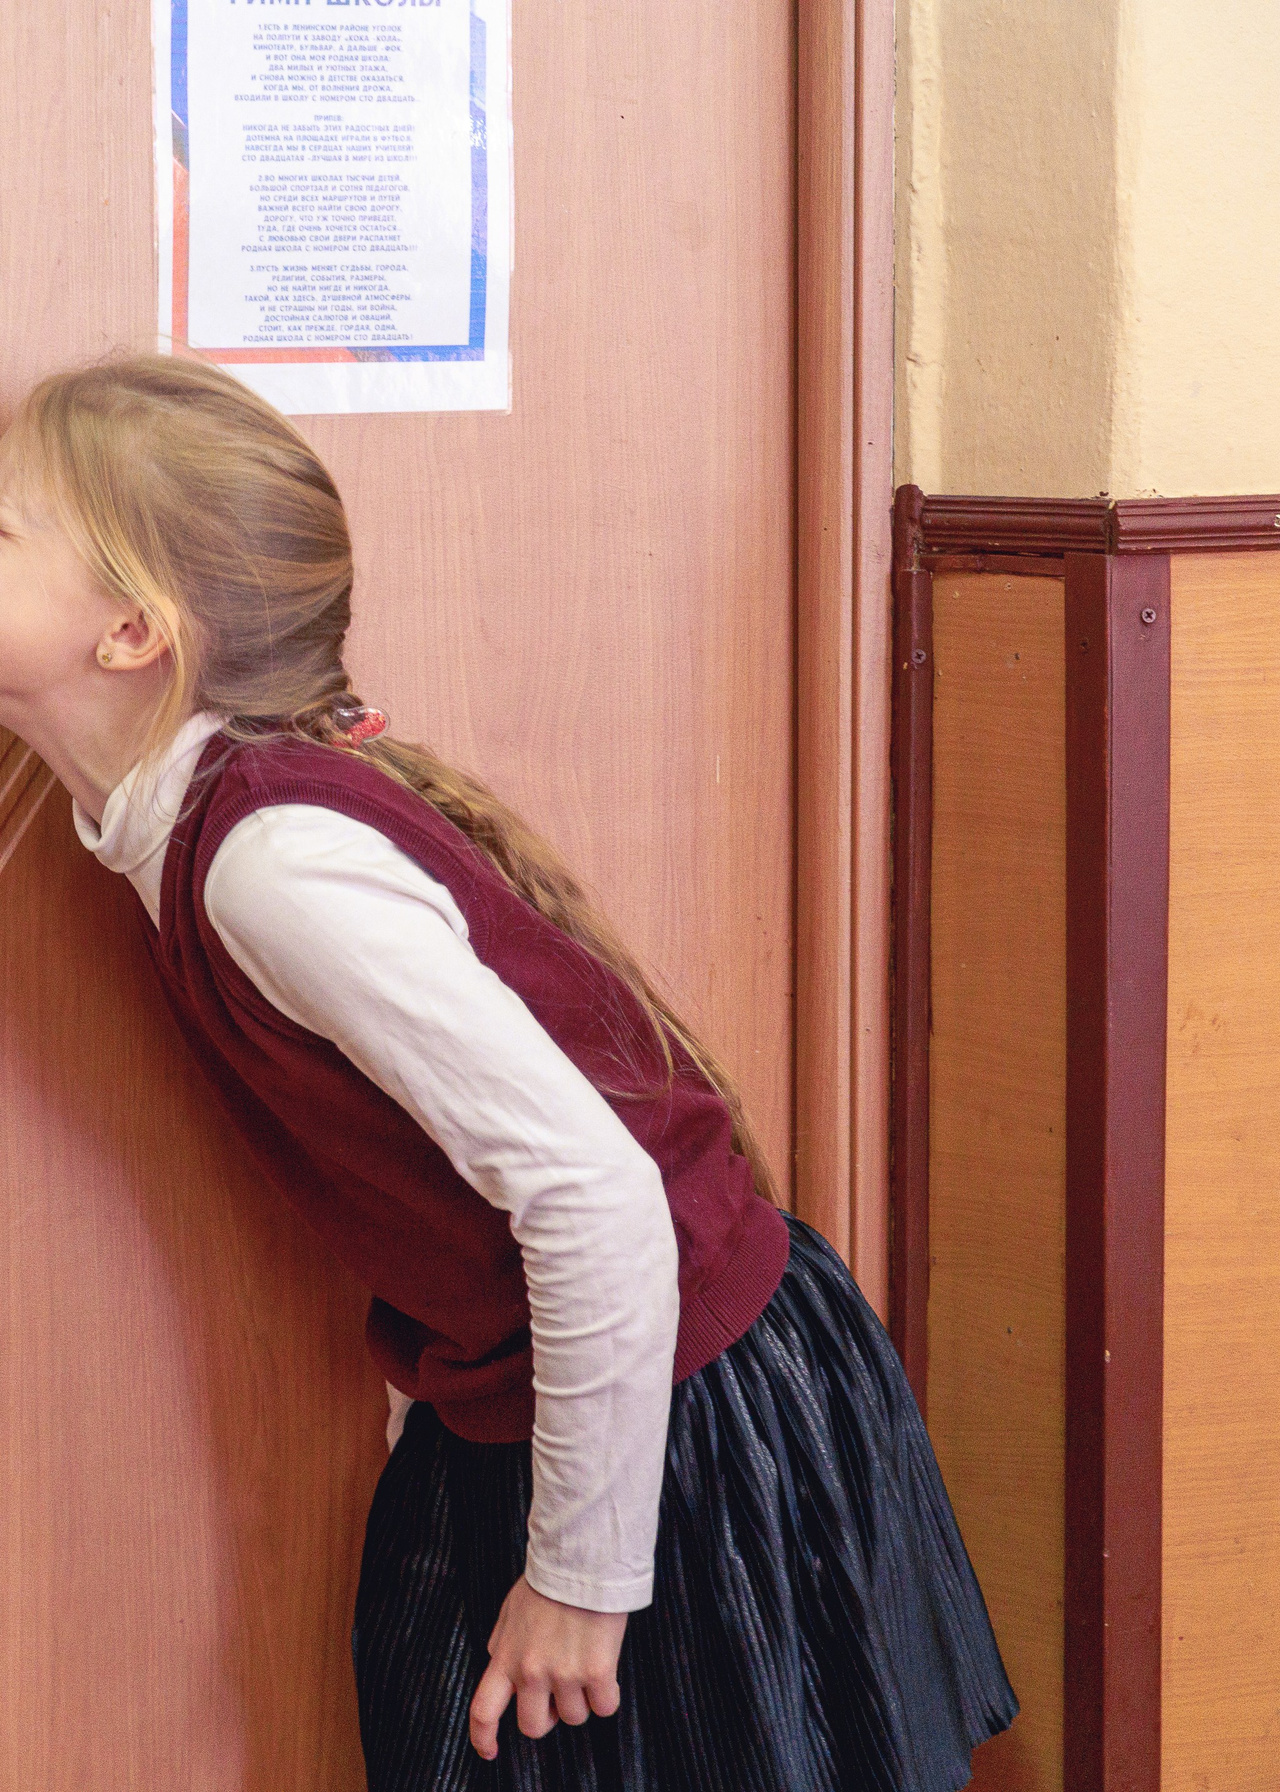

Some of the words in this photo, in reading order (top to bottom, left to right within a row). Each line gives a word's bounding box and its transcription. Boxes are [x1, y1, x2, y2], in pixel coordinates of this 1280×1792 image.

[292, 23, 337, 32] ЛЕНИНСКОМ
[339, 23, 369, 32] РАЙОНЕ
[372, 23, 402, 32] УГОЛОК
[253, 34, 264, 42] НА
[266, 34, 301, 42] ПОЛПУТИ
[312, 34, 341, 42] ЗАВОДУ
[347, 44, 377, 52] ДАЛЬШЕ
[273, 54, 287, 62] ВОТ
[290, 54, 306, 62] ОНА
[309, 54, 326, 62] МОЯ
[328, 54, 359, 62] РОДНАЯ
[268, 64, 284, 72] ДВА
[287, 64, 314, 72] МИЛЫХ
[326, 64, 356, 72] УЮТНЫХ
[259, 74, 285, 82] СНОВА
[287, 74, 318, 82] МОЖНО
[328, 74, 357, 82] ДЕТСТВЕ
[263, 84, 289, 92] КОГДА
[309, 84, 318, 92] ОТ
[321, 84, 360, 92] ВОЛНЕНИЯ
[234, 94, 272, 103] ВХОДИЛИ
[281, 94, 308, 103] ШКОЛУ
[319, 94, 356, 103] НОМЕРОМ
[358, 94, 374, 103] СТО
[242, 124, 278, 132] НИКОГДА
[281, 124, 290, 132] НЕ
[293, 124, 320, 132] ЗАБЫТЬ
[325, 124, 342, 132] ЭТИХ
[345, 124, 390, 132] РАДОСТНЫХ
[245, 134, 281, 143] ДОТЕМНА
[283, 134, 294, 143] НА
[296, 134, 338, 143] ПЛОЩАДКЕ
[341, 134, 371, 143] ИГРАЛИ
[244, 144, 284, 152] НАВСЕГДА
[286, 144, 299, 152] МЫ
[308, 144, 343, 152] СЕРДЦАХ
[346, 144, 372, 152] НАШИХ
[241, 154, 257, 162] СТО
[259, 154, 305, 162] ДВАДЦАТАЯ
[352, 154, 372, 162] МИРЕ
[374, 154, 384, 162] ИЗ
[278, 174, 308, 182] МНОГИХ
[310, 174, 343, 182] ШКОЛАХ
[346, 174, 375, 182] ТЫСЯЧИ
[249, 184, 288, 192] БОЛЬШОЙ
[290, 184, 329, 192] СПОРТЗАЛ
[339, 184, 363, 192] СОТНЯ
[259, 194, 271, 203] НО
[273, 194, 298, 203] СРЕДИ
[300, 194, 319, 203] ВСЕХ
[322, 194, 367, 203] МАРШРУТОВ
[378, 194, 401, 203] ПУТЕЙ
[257, 204, 289, 212] ВАЖНЕЙ
[291, 204, 315, 212] ВСЕГО
[317, 204, 342, 212] НАЙТИ
[344, 204, 367, 212] СВОЮ
[299, 214, 314, 223] ЧТО
[316, 214, 328, 223] УЖ
[331, 214, 356, 223] ТОЧНО
[282, 224, 295, 232] ГДЕ
[298, 224, 322, 232] ОЧЕНЬ
[325, 224, 357, 232] ХОЧЕТСЯ
[268, 234, 307, 242] ЛЮБОВЬЮ
[309, 234, 330, 242] СВОИ
[333, 234, 357, 242] ДВЕРИ
[359, 234, 401, 242] РАСПАХНЕТ
[241, 244, 272, 253] РОДНАЯ
[274, 244, 302, 253] ШКОЛА
[312, 244, 350, 253] НОМЕРОМ
[352, 244, 367, 253] СТО
[282, 264, 308, 272] ЖИЗНЬ
[311, 264, 337, 272] МЕНЯЕТ
[266, 284, 278, 292] НО
[280, 284, 289, 292] НЕ
[292, 284, 316, 292] НАЙТИ
[318, 284, 342, 292] НИГДЕ
[274, 294, 289, 302] КАК
[321, 294, 362, 302] ДУШЕВНОЙ
[267, 304, 276, 312] НЕ
[279, 304, 315, 312] СТРАШНЫ
[317, 304, 328, 312] НИ
[357, 304, 367, 312] НИ
[264, 314, 310, 322] ДОСТОЙНАЯ
[312, 314, 349, 322] САЛЮТОВ
[287, 324, 302, 332] КАК
[242, 334, 274, 342] РОДНАЯ
[276, 334, 304, 342] ШКОЛА
[314, 334, 351, 342] НОМЕРОМ
[353, 334, 368, 342] СТО
